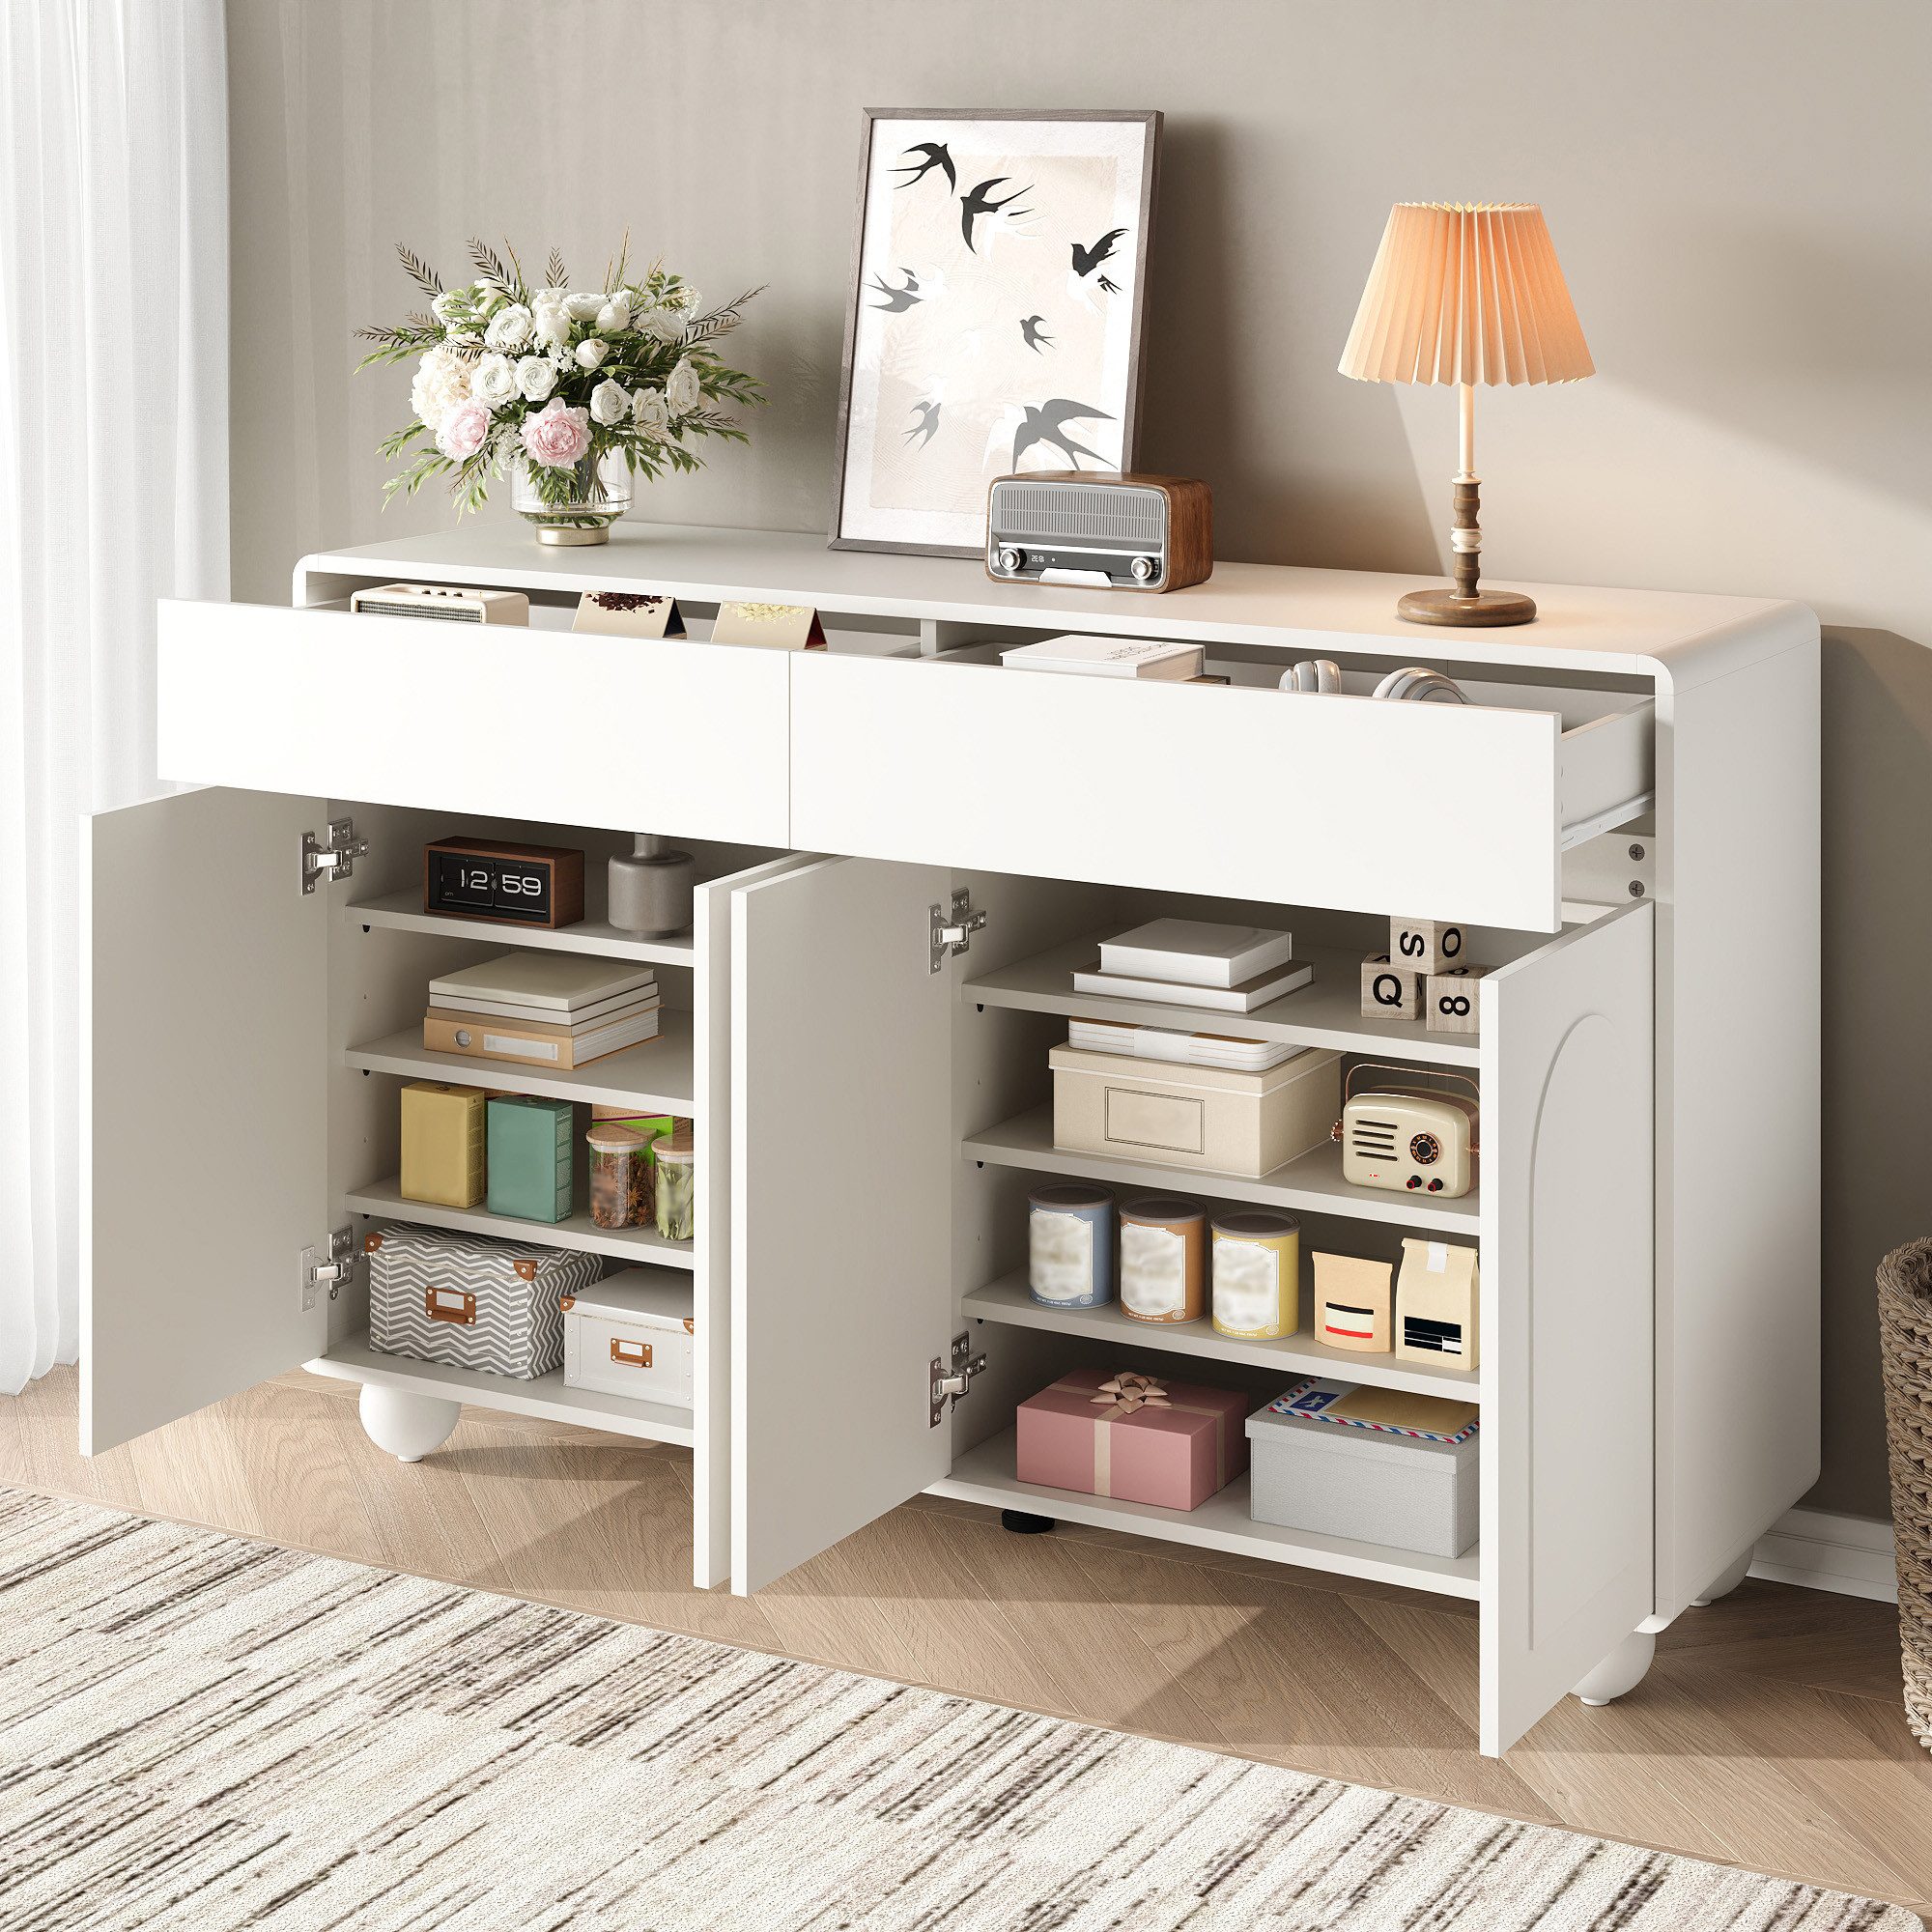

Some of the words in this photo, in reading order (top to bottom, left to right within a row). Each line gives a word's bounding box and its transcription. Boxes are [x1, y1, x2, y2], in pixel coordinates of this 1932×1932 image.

[502, 874, 541, 896] 59
[1399, 931, 1425, 957] S
[1441, 927, 1462, 958] O
[1373, 974, 1404, 1009] Q
[1438, 996, 1470, 1016] 8
